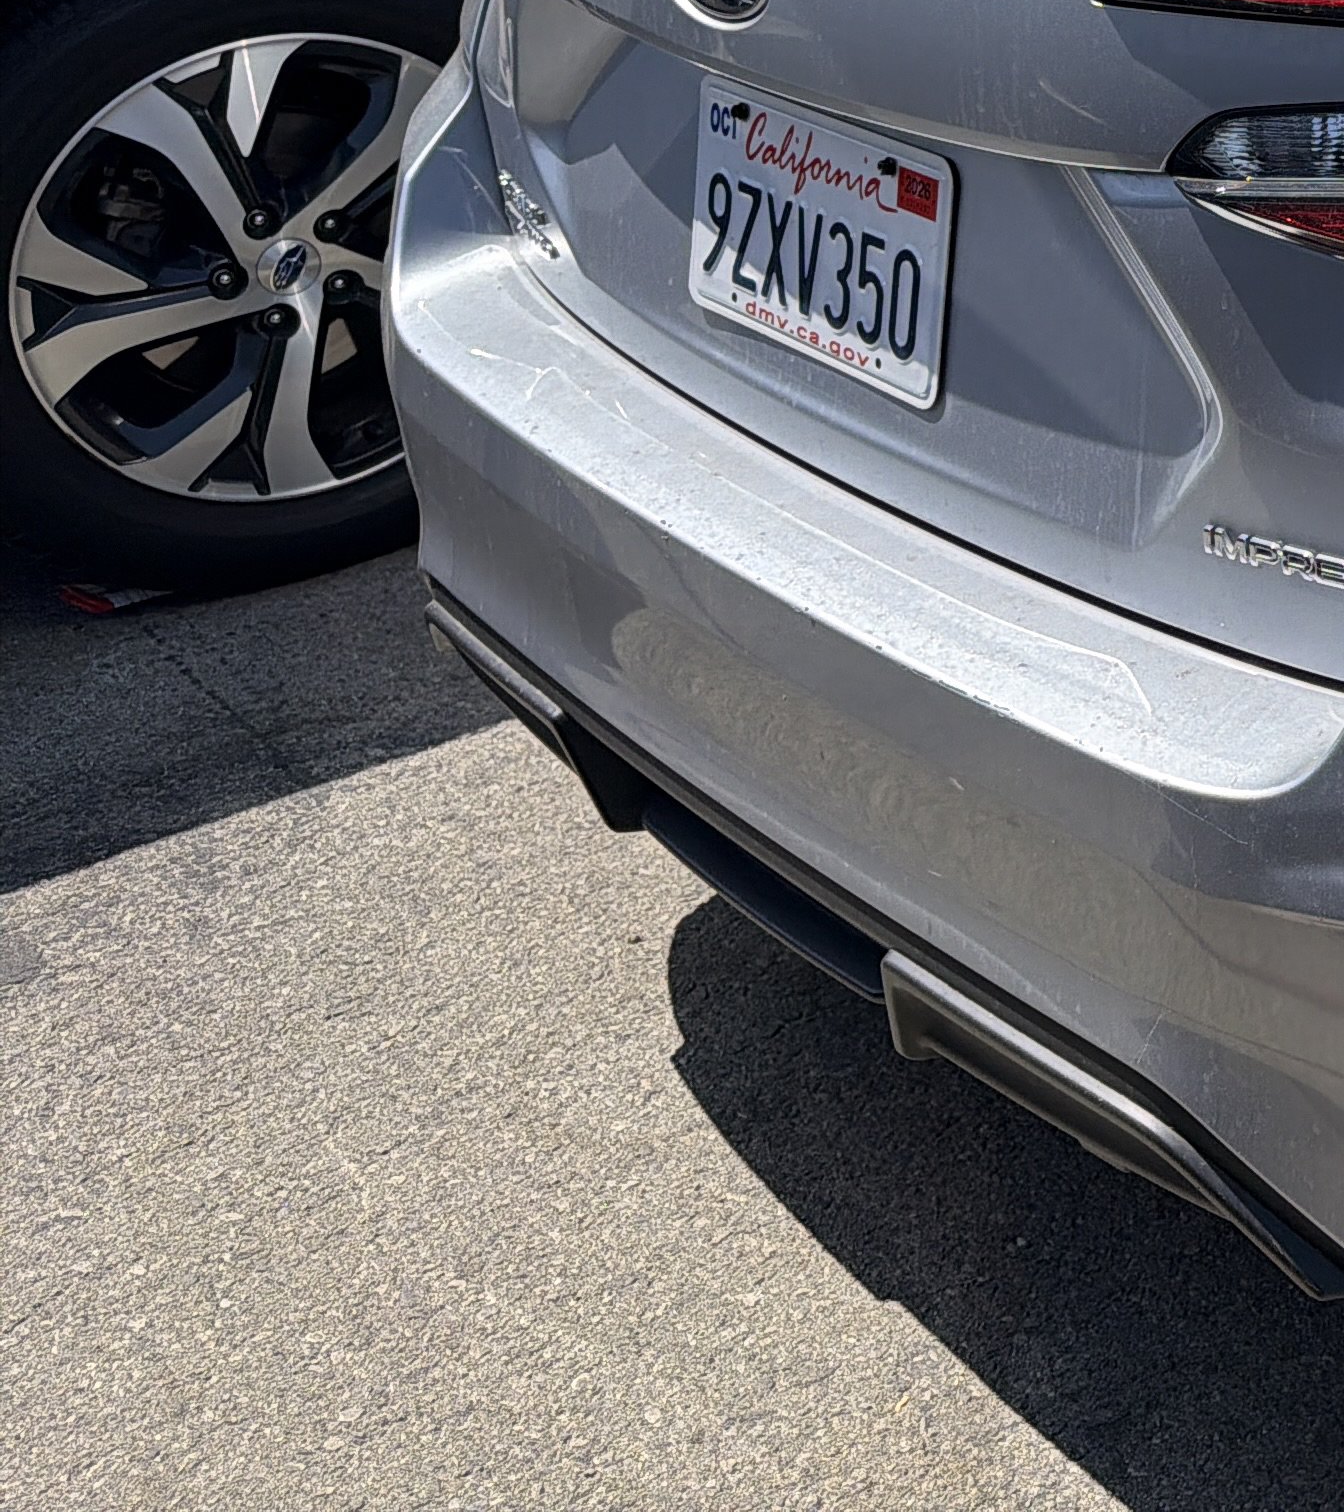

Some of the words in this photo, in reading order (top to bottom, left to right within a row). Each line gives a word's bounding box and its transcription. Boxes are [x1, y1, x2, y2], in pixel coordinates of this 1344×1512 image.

[745, 111, 898, 214] California
[702, 172, 921, 360] 9ZXV350
[744, 300, 870, 366] dmv.ca.gov
